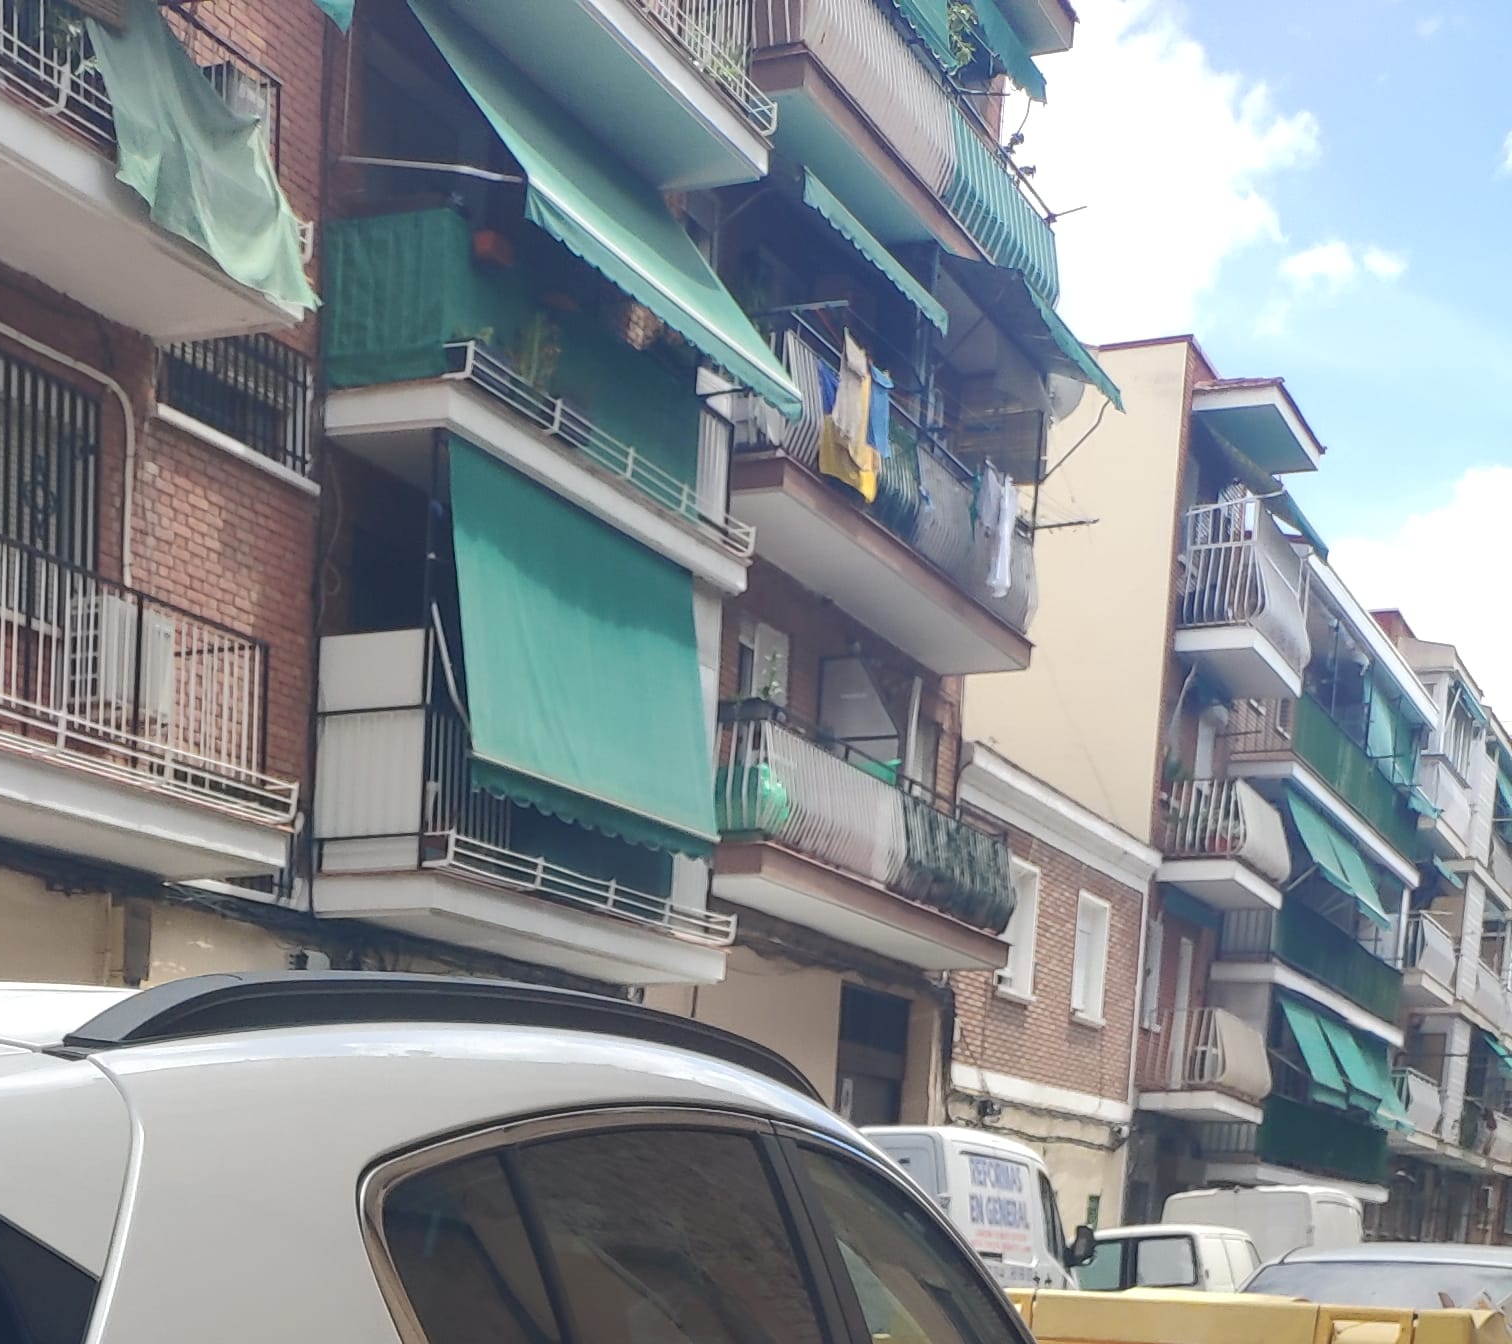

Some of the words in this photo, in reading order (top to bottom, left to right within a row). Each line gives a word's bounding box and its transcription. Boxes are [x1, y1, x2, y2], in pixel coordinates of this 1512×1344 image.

[969, 1156, 1023, 1193] REFORMAS
[969, 1193, 984, 1224] EN
[986, 1195, 1030, 1229] GENERAL
